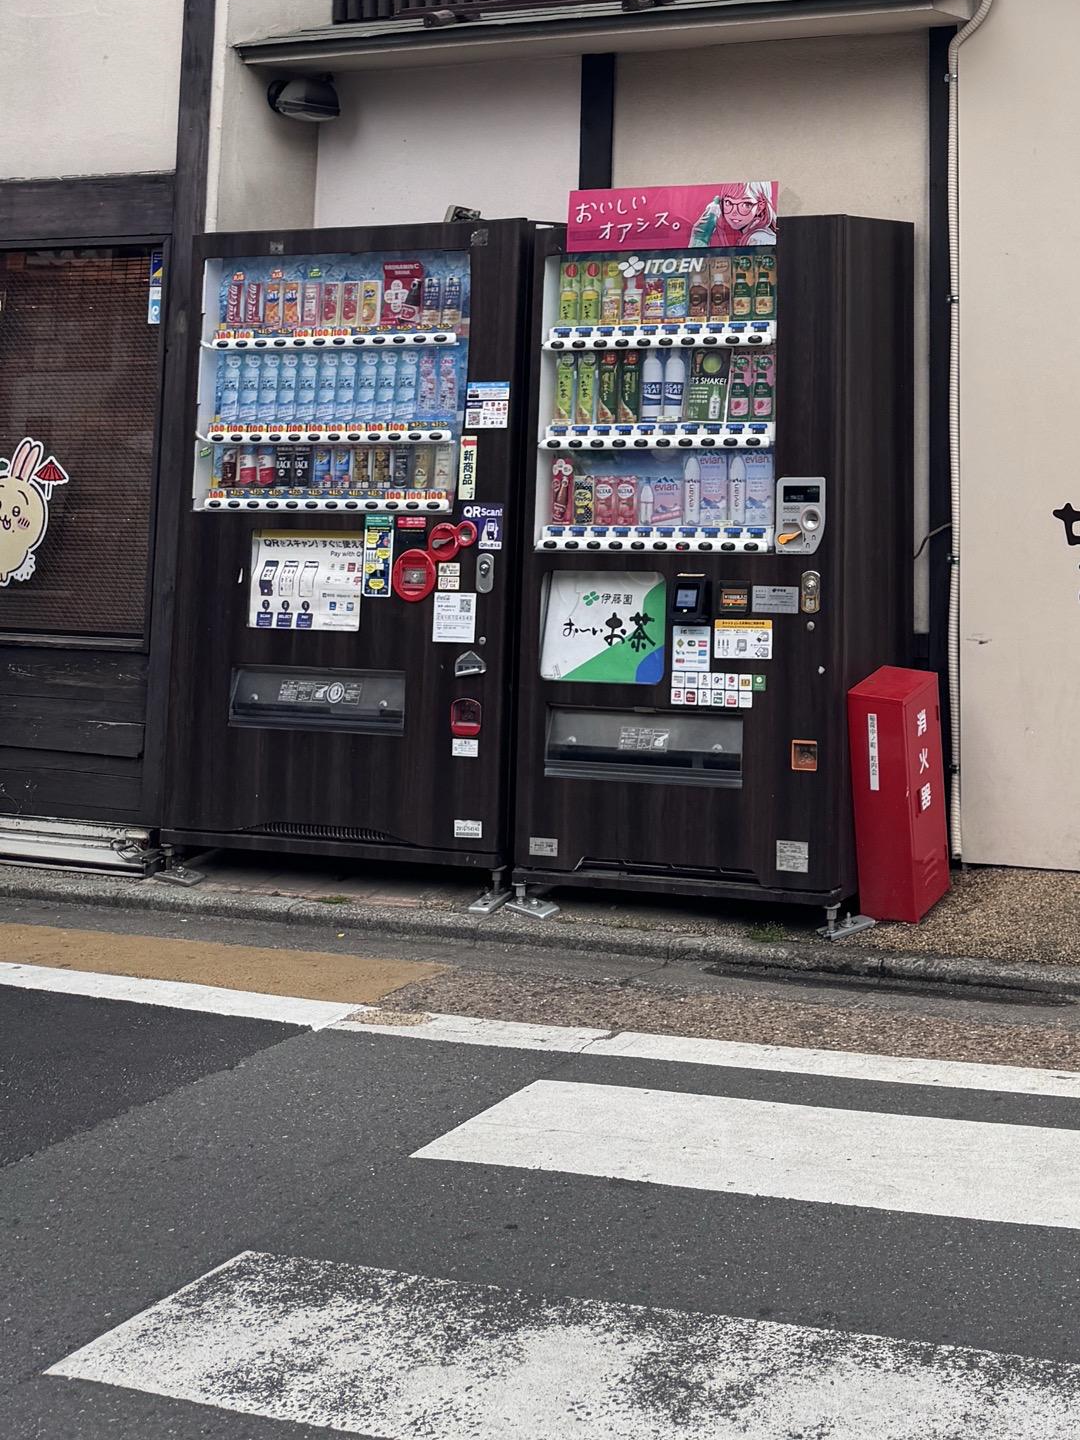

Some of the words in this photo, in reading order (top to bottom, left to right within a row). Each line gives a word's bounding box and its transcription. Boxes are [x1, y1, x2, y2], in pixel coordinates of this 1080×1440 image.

[576, 195, 647, 224] おいしい
[598, 211, 681, 243] オアシス。
[644, 258, 678, 274] ITO
[679, 257, 704, 273] EN
[295, 329, 309, 337] 100
[333, 328, 348, 336] 100
[308, 424, 323, 432] 100
[368, 423, 383, 431] 100
[389, 423, 405, 431] 100
[463, 450, 474, 486] 新商品
[386, 491, 401, 499] 100
[407, 491, 421, 499] 100
[427, 491, 443, 499] 100
[601, 593, 633, 605] 伊藤園
[917, 709, 932, 811] 消火器
